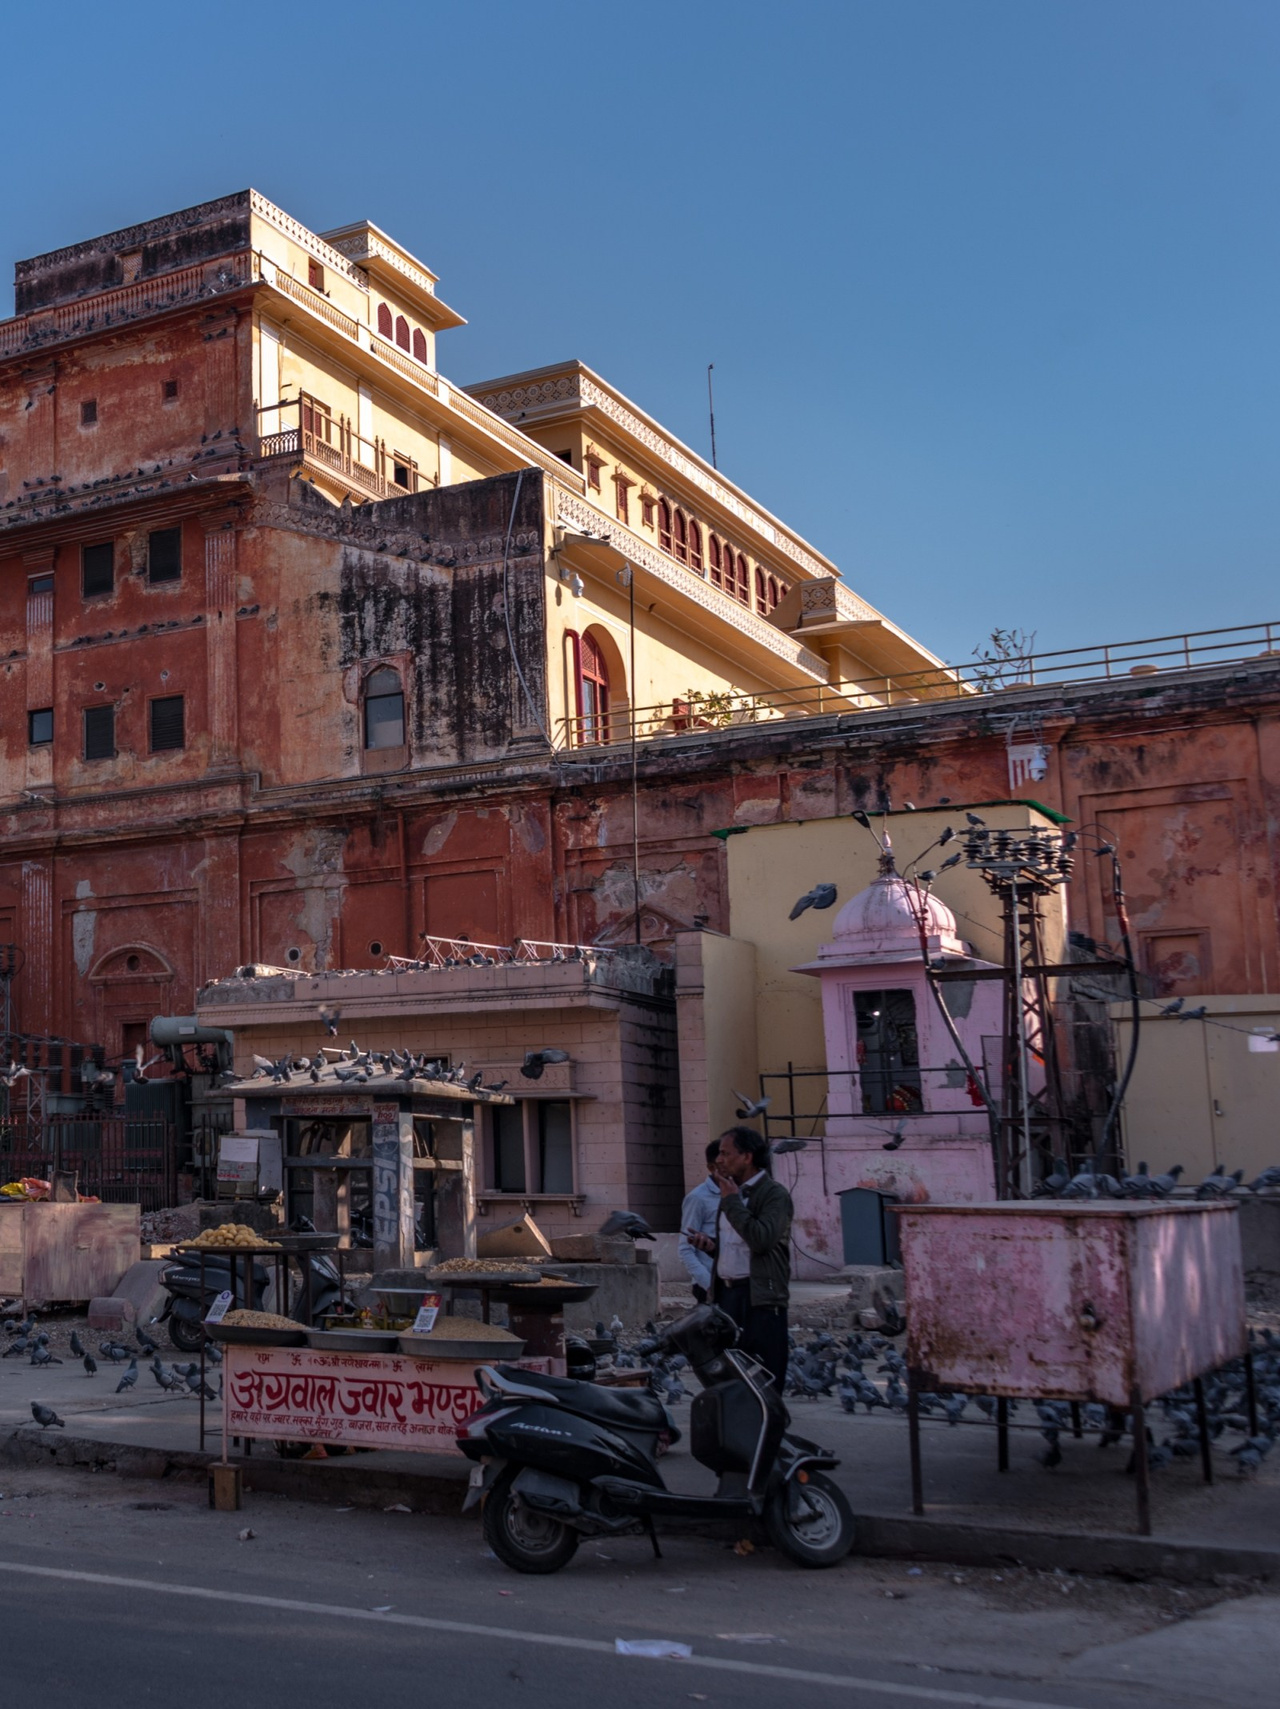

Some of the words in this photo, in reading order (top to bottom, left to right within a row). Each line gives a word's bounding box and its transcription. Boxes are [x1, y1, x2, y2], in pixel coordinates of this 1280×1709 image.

[230, 1369, 341, 1416] अग्रवाल
[338, 1377, 406, 1422] ज्वार
[231, 1409, 248, 1424] हमारे
